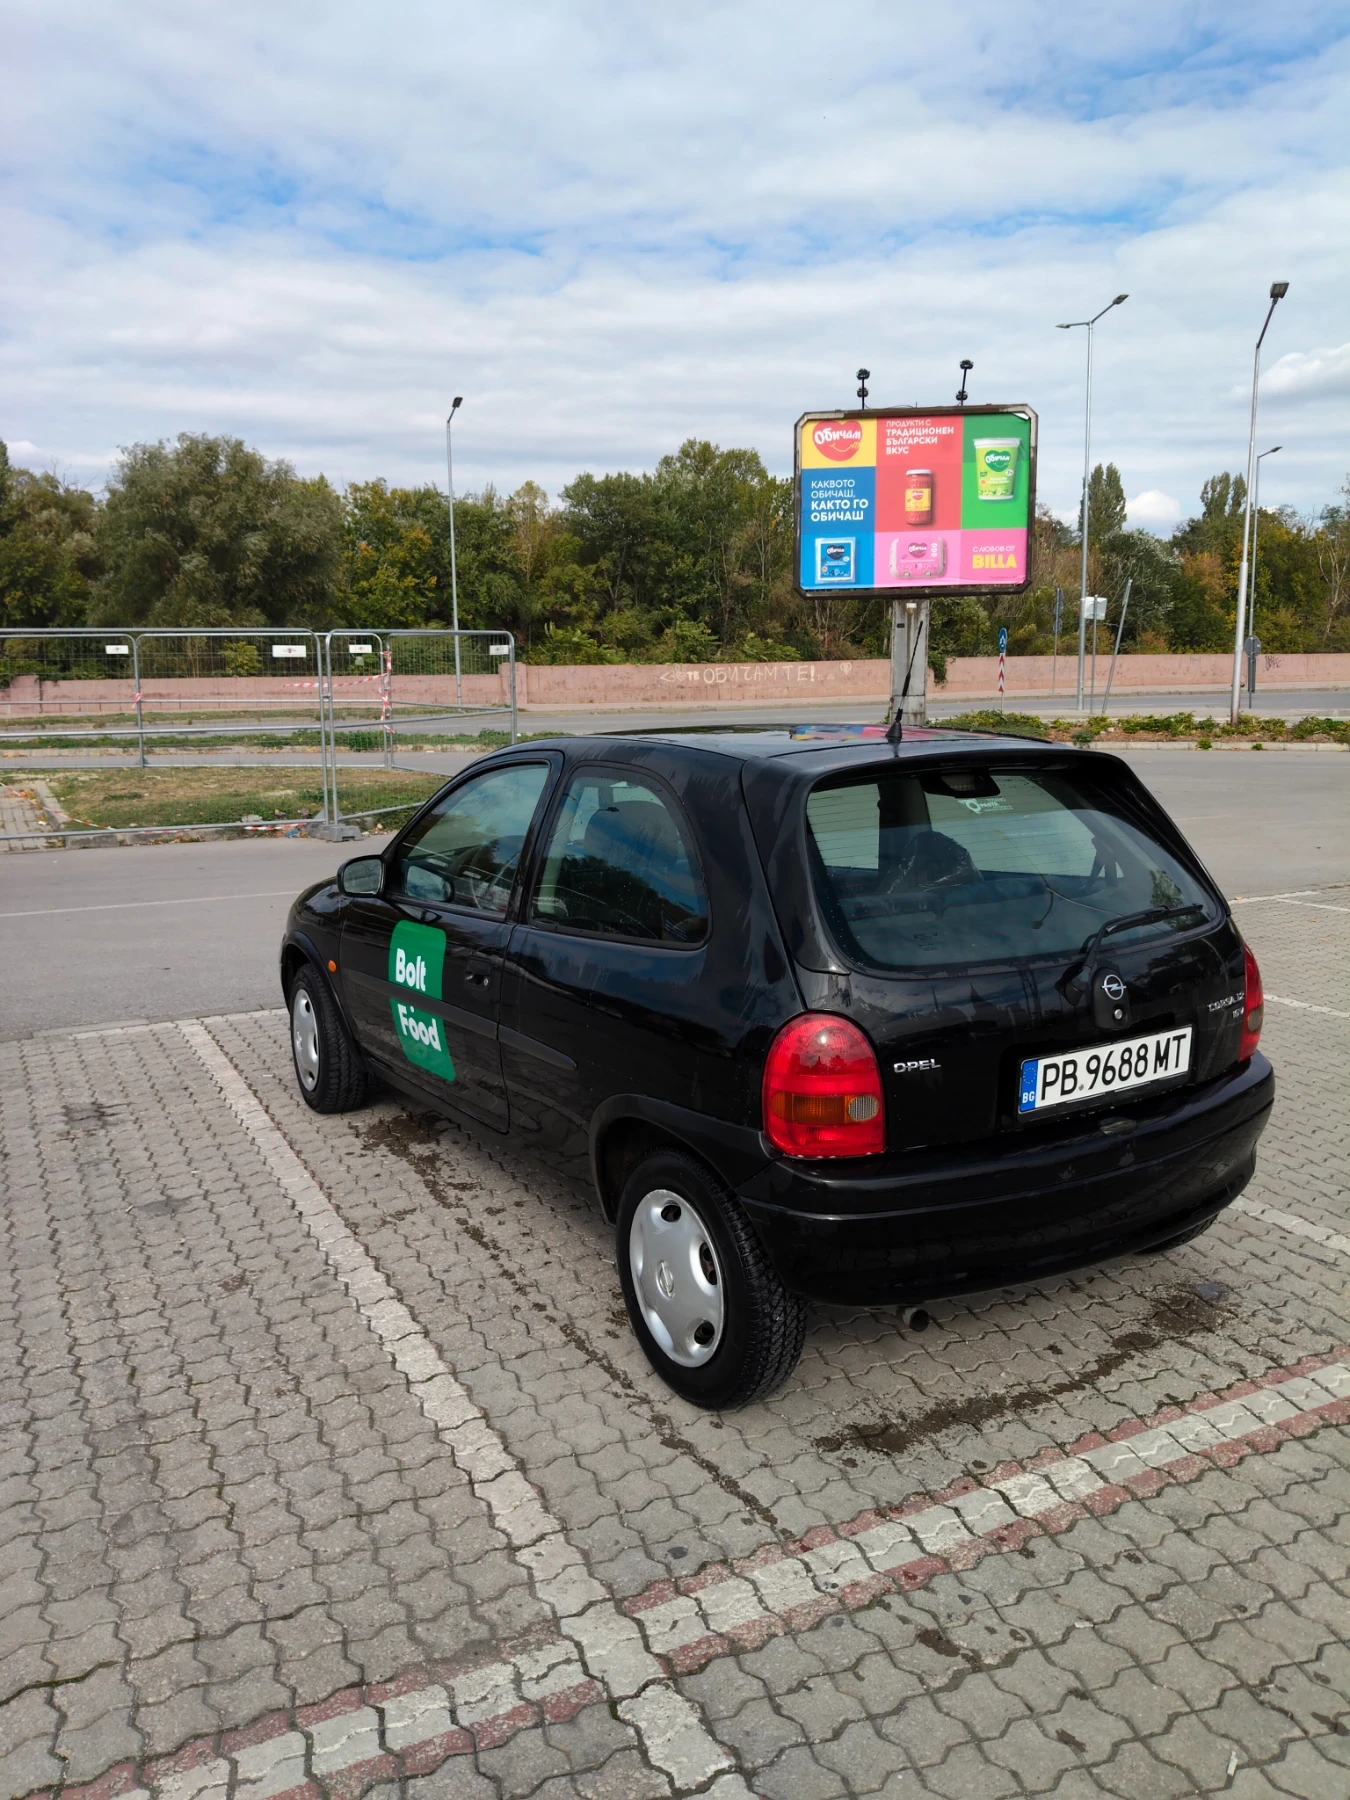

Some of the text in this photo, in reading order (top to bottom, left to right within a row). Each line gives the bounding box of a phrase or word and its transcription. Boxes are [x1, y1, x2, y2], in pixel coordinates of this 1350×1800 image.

[886, 420, 924, 428] ПРОДУКТИ
[814, 427, 861, 445] Обичам
[886, 427, 954, 437] ТРАДИЦИОНЕН
[886, 436, 938, 446] БЪЛГАРСКИ
[886, 446, 909, 455] ВКУС
[811, 479, 855, 489] КАКВОТО
[811, 499, 869, 510] КАКТО ГО
[811, 510, 864, 522] ОБИЧАШ
[972, 553, 1018, 569] BILLA
[395, 948, 427, 992] Bolt
[397, 1003, 442, 1052] Food
[893, 1058, 941, 1074] OPEL
[1022, 1090, 1035, 1104] BG
